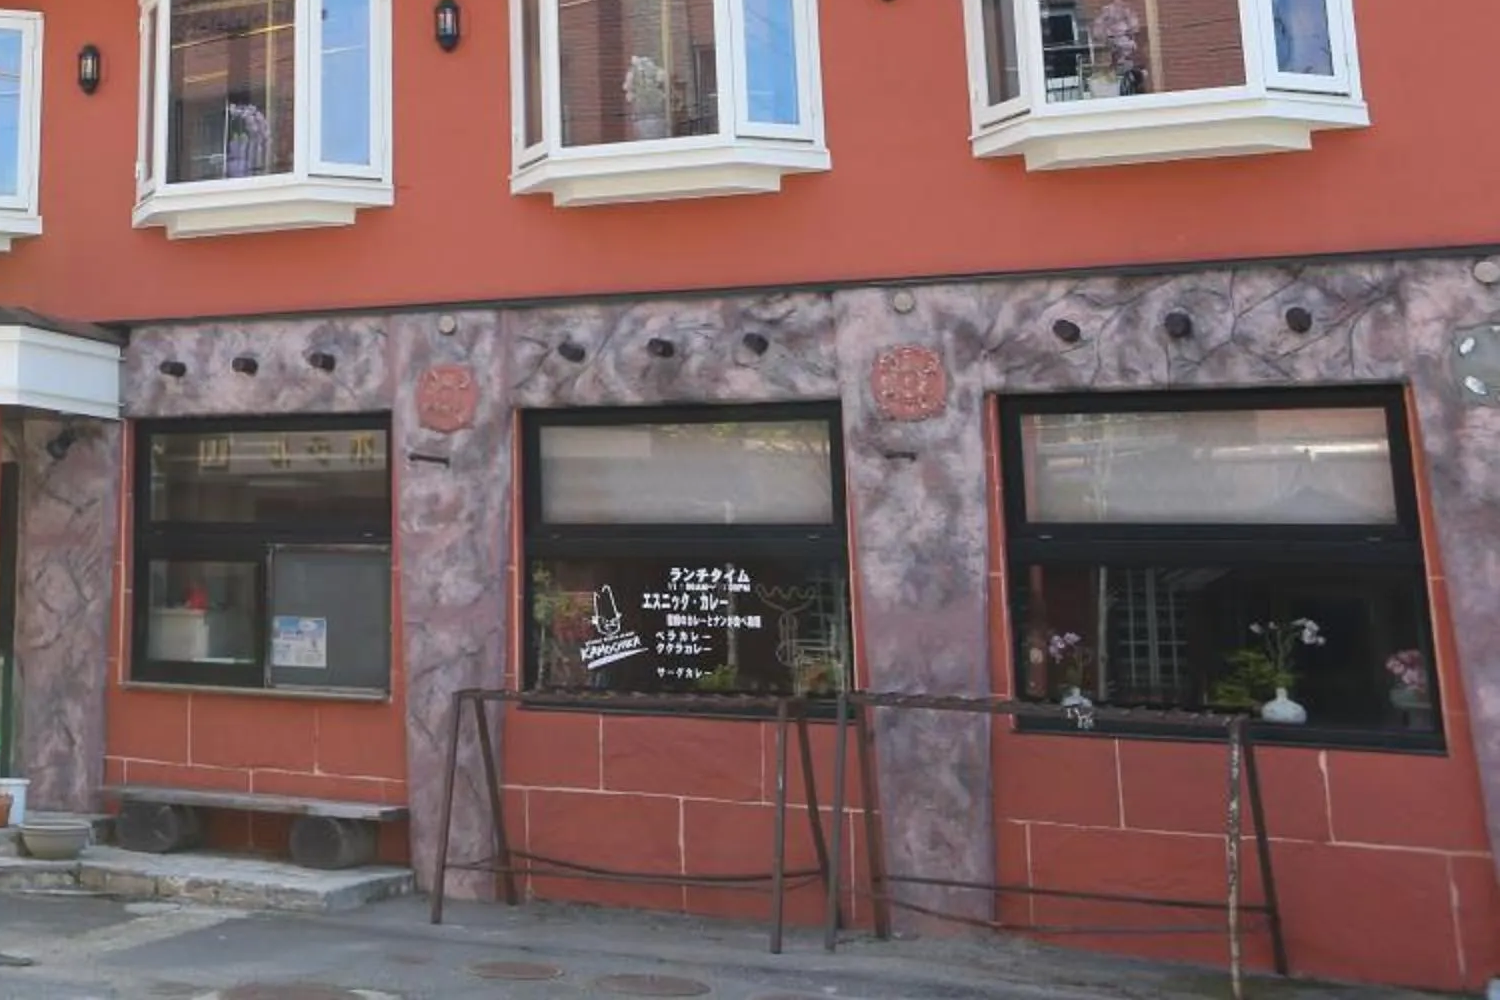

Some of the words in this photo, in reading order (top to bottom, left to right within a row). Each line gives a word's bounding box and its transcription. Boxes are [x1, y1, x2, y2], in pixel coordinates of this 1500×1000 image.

[669, 567, 751, 583] ランチタイム
[641, 593, 729, 611] エスニック・カレー
